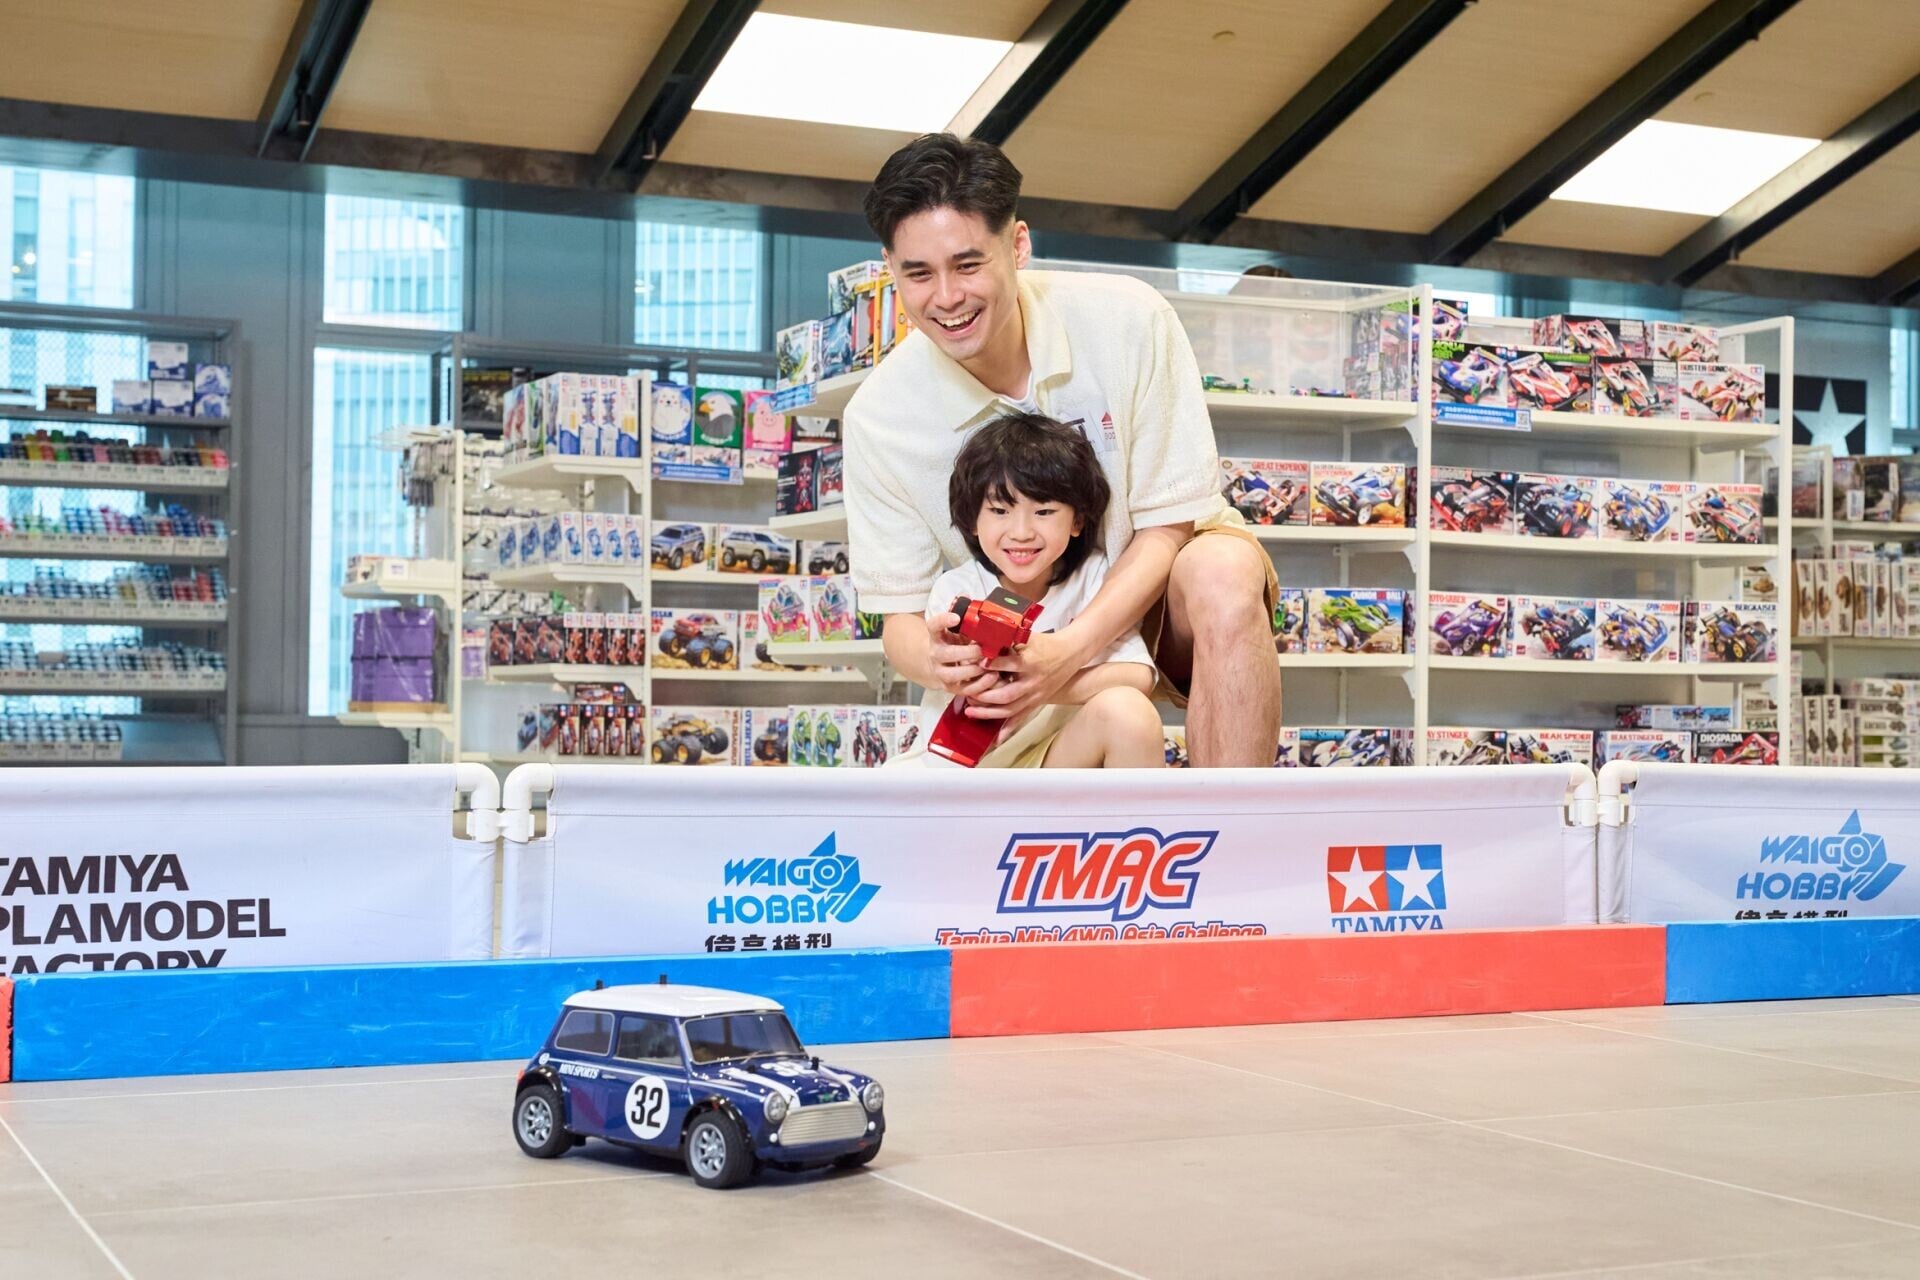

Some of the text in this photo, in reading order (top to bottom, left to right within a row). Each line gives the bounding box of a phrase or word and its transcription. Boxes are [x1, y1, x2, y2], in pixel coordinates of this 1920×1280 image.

[1252, 461, 1274, 471] GREAT
[1437, 730, 1469, 740] STINGER
[1539, 732, 1562, 740] BEAK
[1700, 733, 1743, 743] DIOSPADA
[1760, 834, 1871, 866] WAIGO
[0, 854, 189, 896] AMIYA
[724, 857, 843, 888] WAIGO
[1001, 831, 1214, 918] TMAC
[1736, 872, 1868, 901] HOBBY
[707, 894, 844, 924] HOBBY
[1332, 914, 1443, 933] TAMIYA
[631, 1084, 663, 1128] 32
